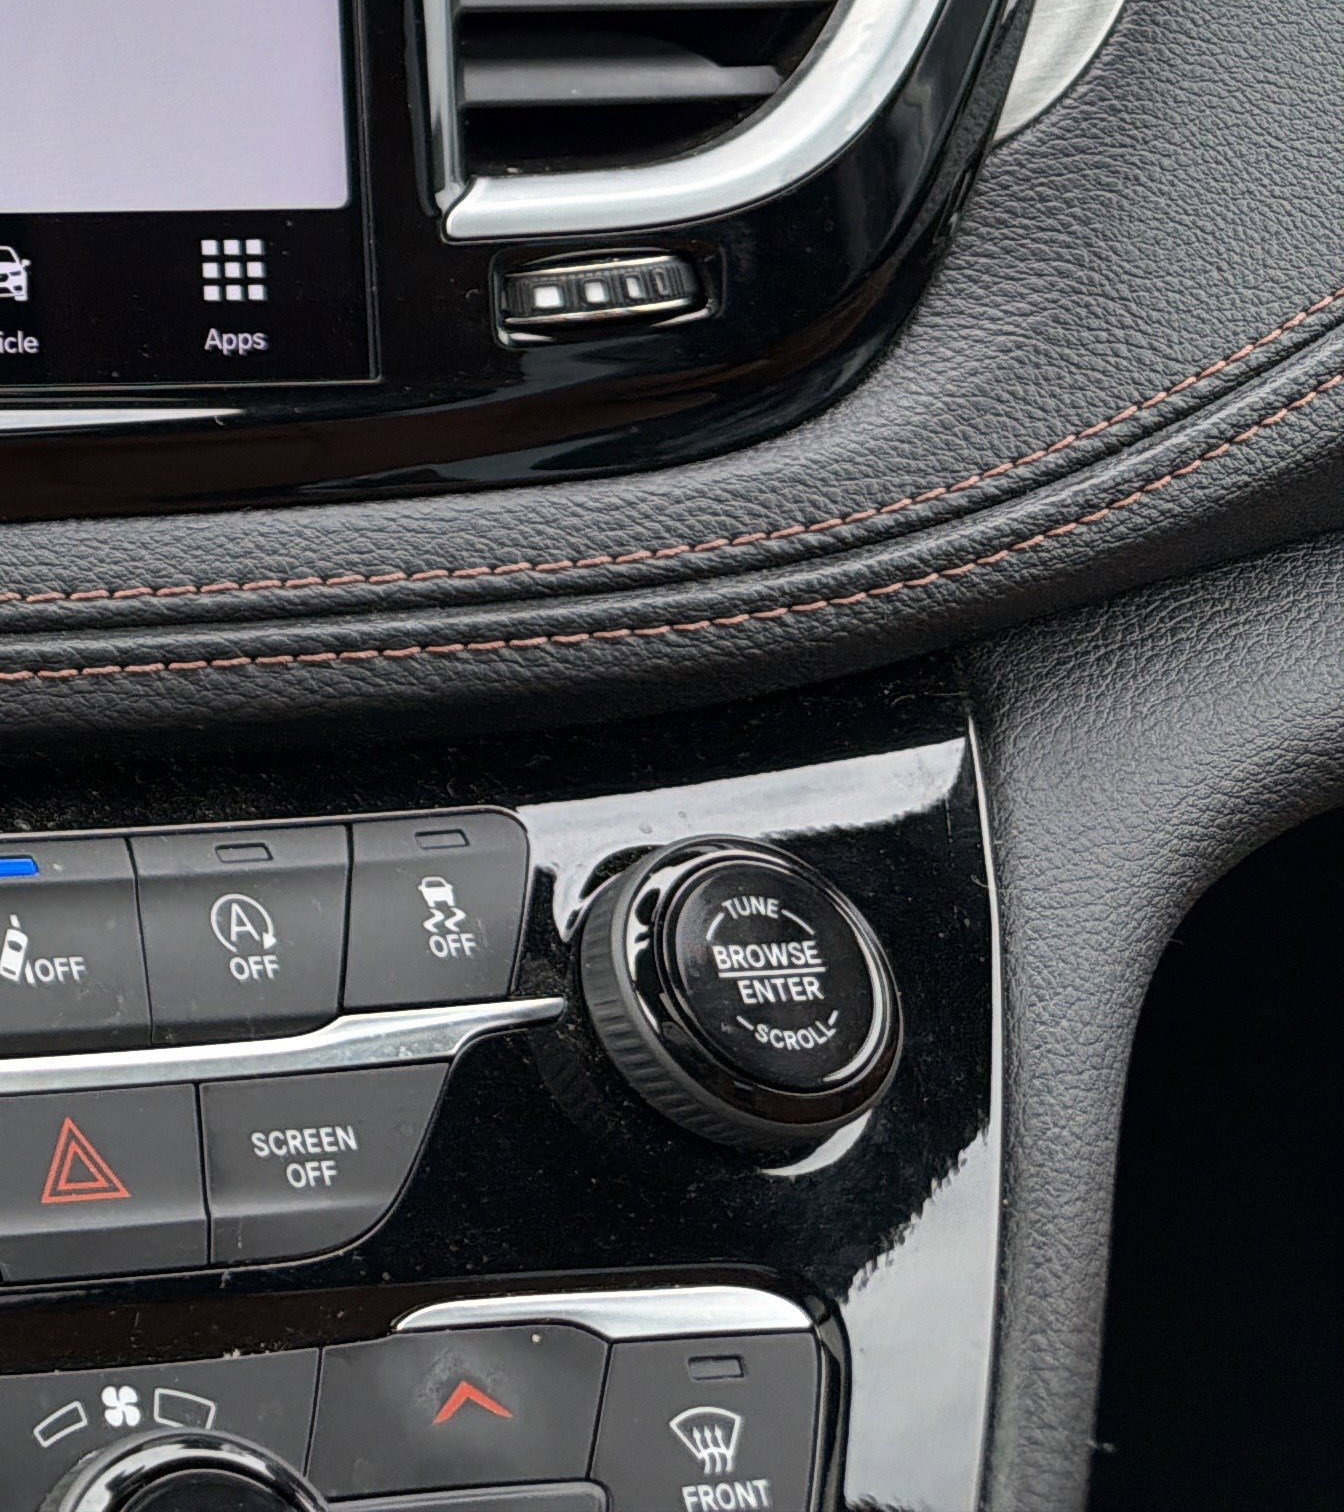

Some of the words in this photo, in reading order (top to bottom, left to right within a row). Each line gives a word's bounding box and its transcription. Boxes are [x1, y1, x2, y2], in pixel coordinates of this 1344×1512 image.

[204, 328, 268, 355] Apps
[721, 896, 780, 919] TUNE
[429, 933, 478, 958] OFF
[712, 940, 822, 969] BROWSE
[35, 957, 86, 983] OFF
[229, 955, 279, 980] OFF
[737, 977, 824, 1004] ENTER
[755, 1021, 836, 1050] SCROLL
[251, 1125, 358, 1157] SCREEN
[285, 1160, 338, 1188] OFF
[681, 1478, 770, 1511] FRONT
